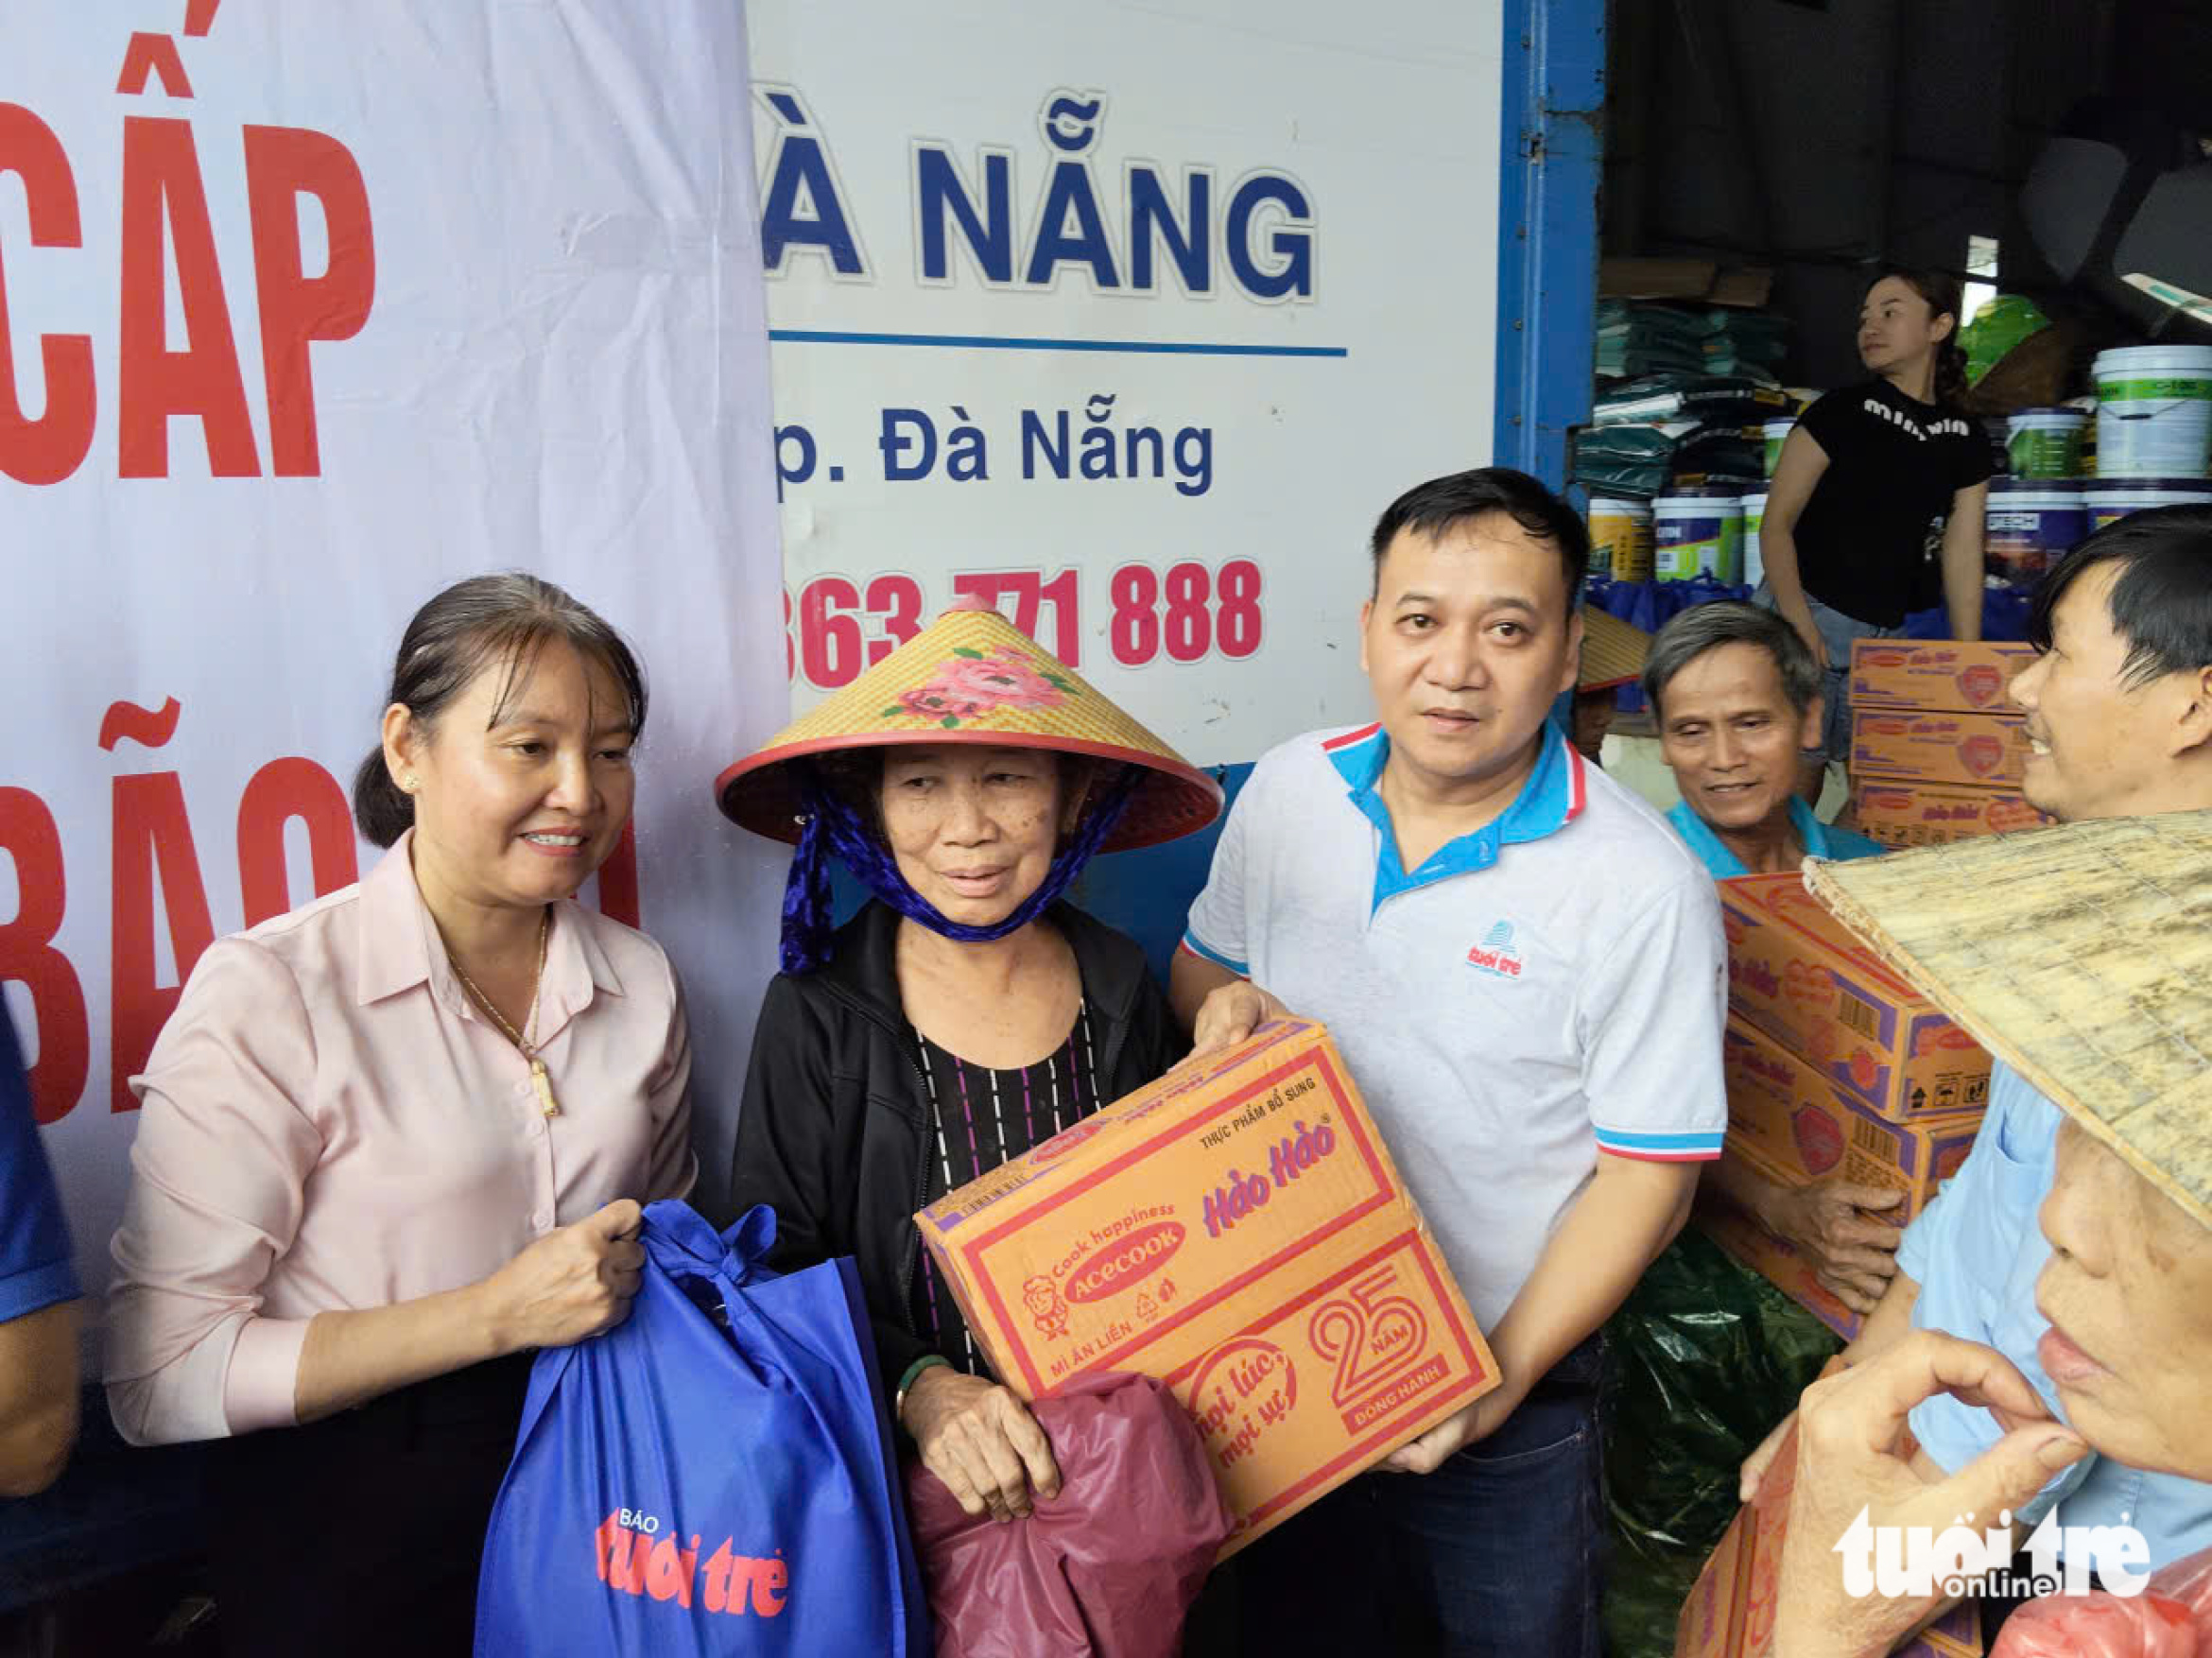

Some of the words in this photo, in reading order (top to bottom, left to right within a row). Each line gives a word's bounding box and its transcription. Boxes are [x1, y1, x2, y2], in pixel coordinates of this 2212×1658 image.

[917, 96, 1311, 298] NẴNG
[879, 406, 990, 481] Đà
[1021, 394, 1213, 496] Nẵng
[784, 575, 923, 688] 63
[1111, 560, 1261, 665] 888
[1286, 1078, 1316, 1101] SUNG
[1202, 1169, 1270, 1237] Hảo
[1270, 1120, 1336, 1187] Hảo
[1052, 1240, 1091, 1277] Cook
[1089, 1203, 1176, 1245] happiness
[1309, 1264, 1427, 1409] 25
[619, 1508, 660, 1533] BÁO
